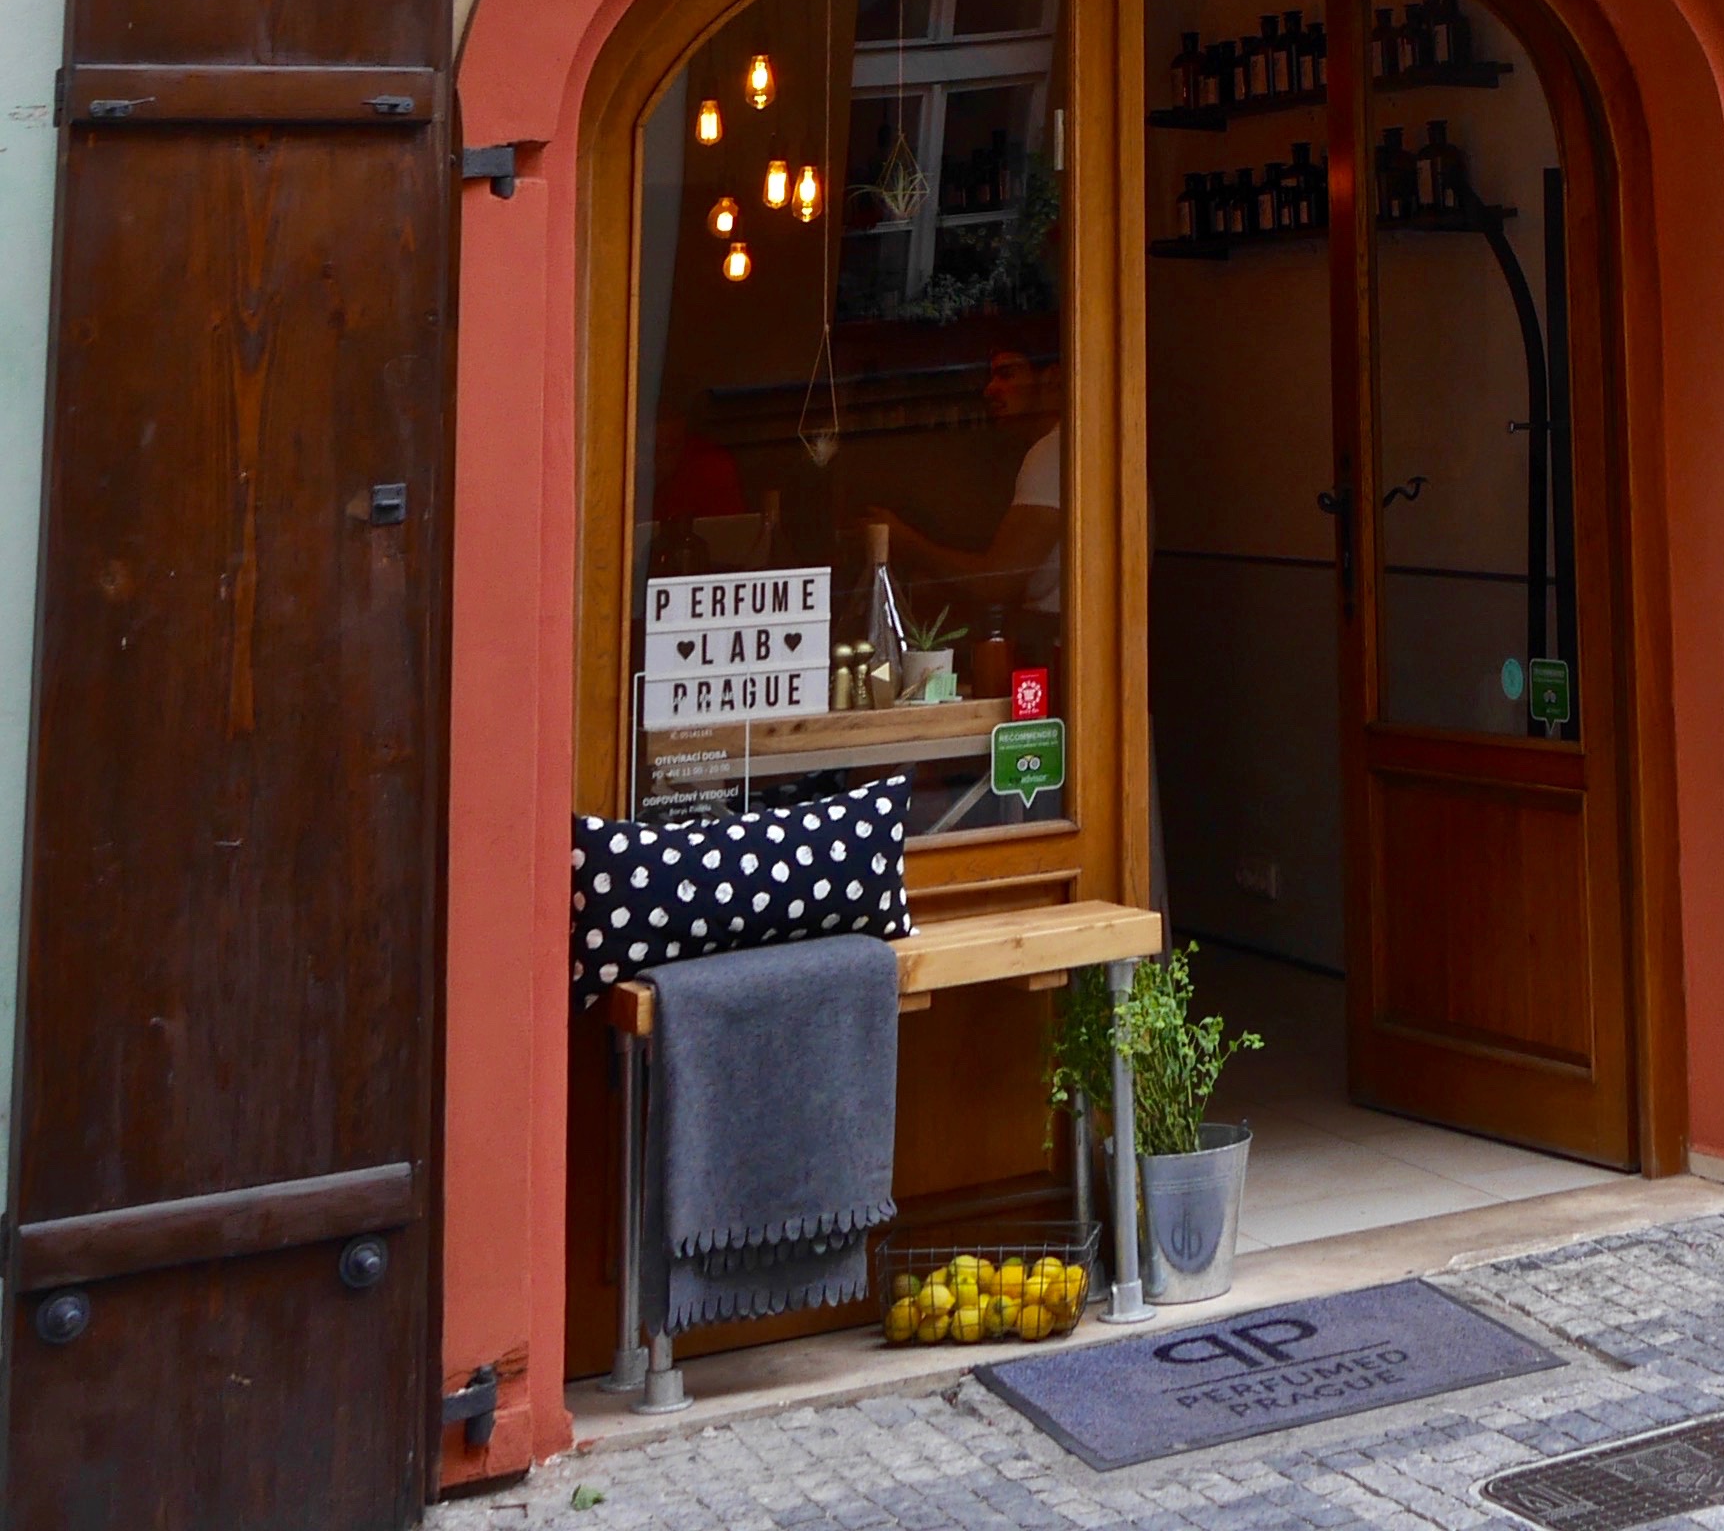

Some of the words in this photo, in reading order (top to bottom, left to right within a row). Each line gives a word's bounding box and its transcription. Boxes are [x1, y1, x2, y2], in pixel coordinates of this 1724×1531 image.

[656, 579, 815, 621] PERFUME
[701, 629, 771, 665] LAB
[672, 673, 801, 715] PRAGUE
[1176, 1348, 1409, 1410] PERFUMED
[1229, 1369, 1406, 1418] PRAGUE
